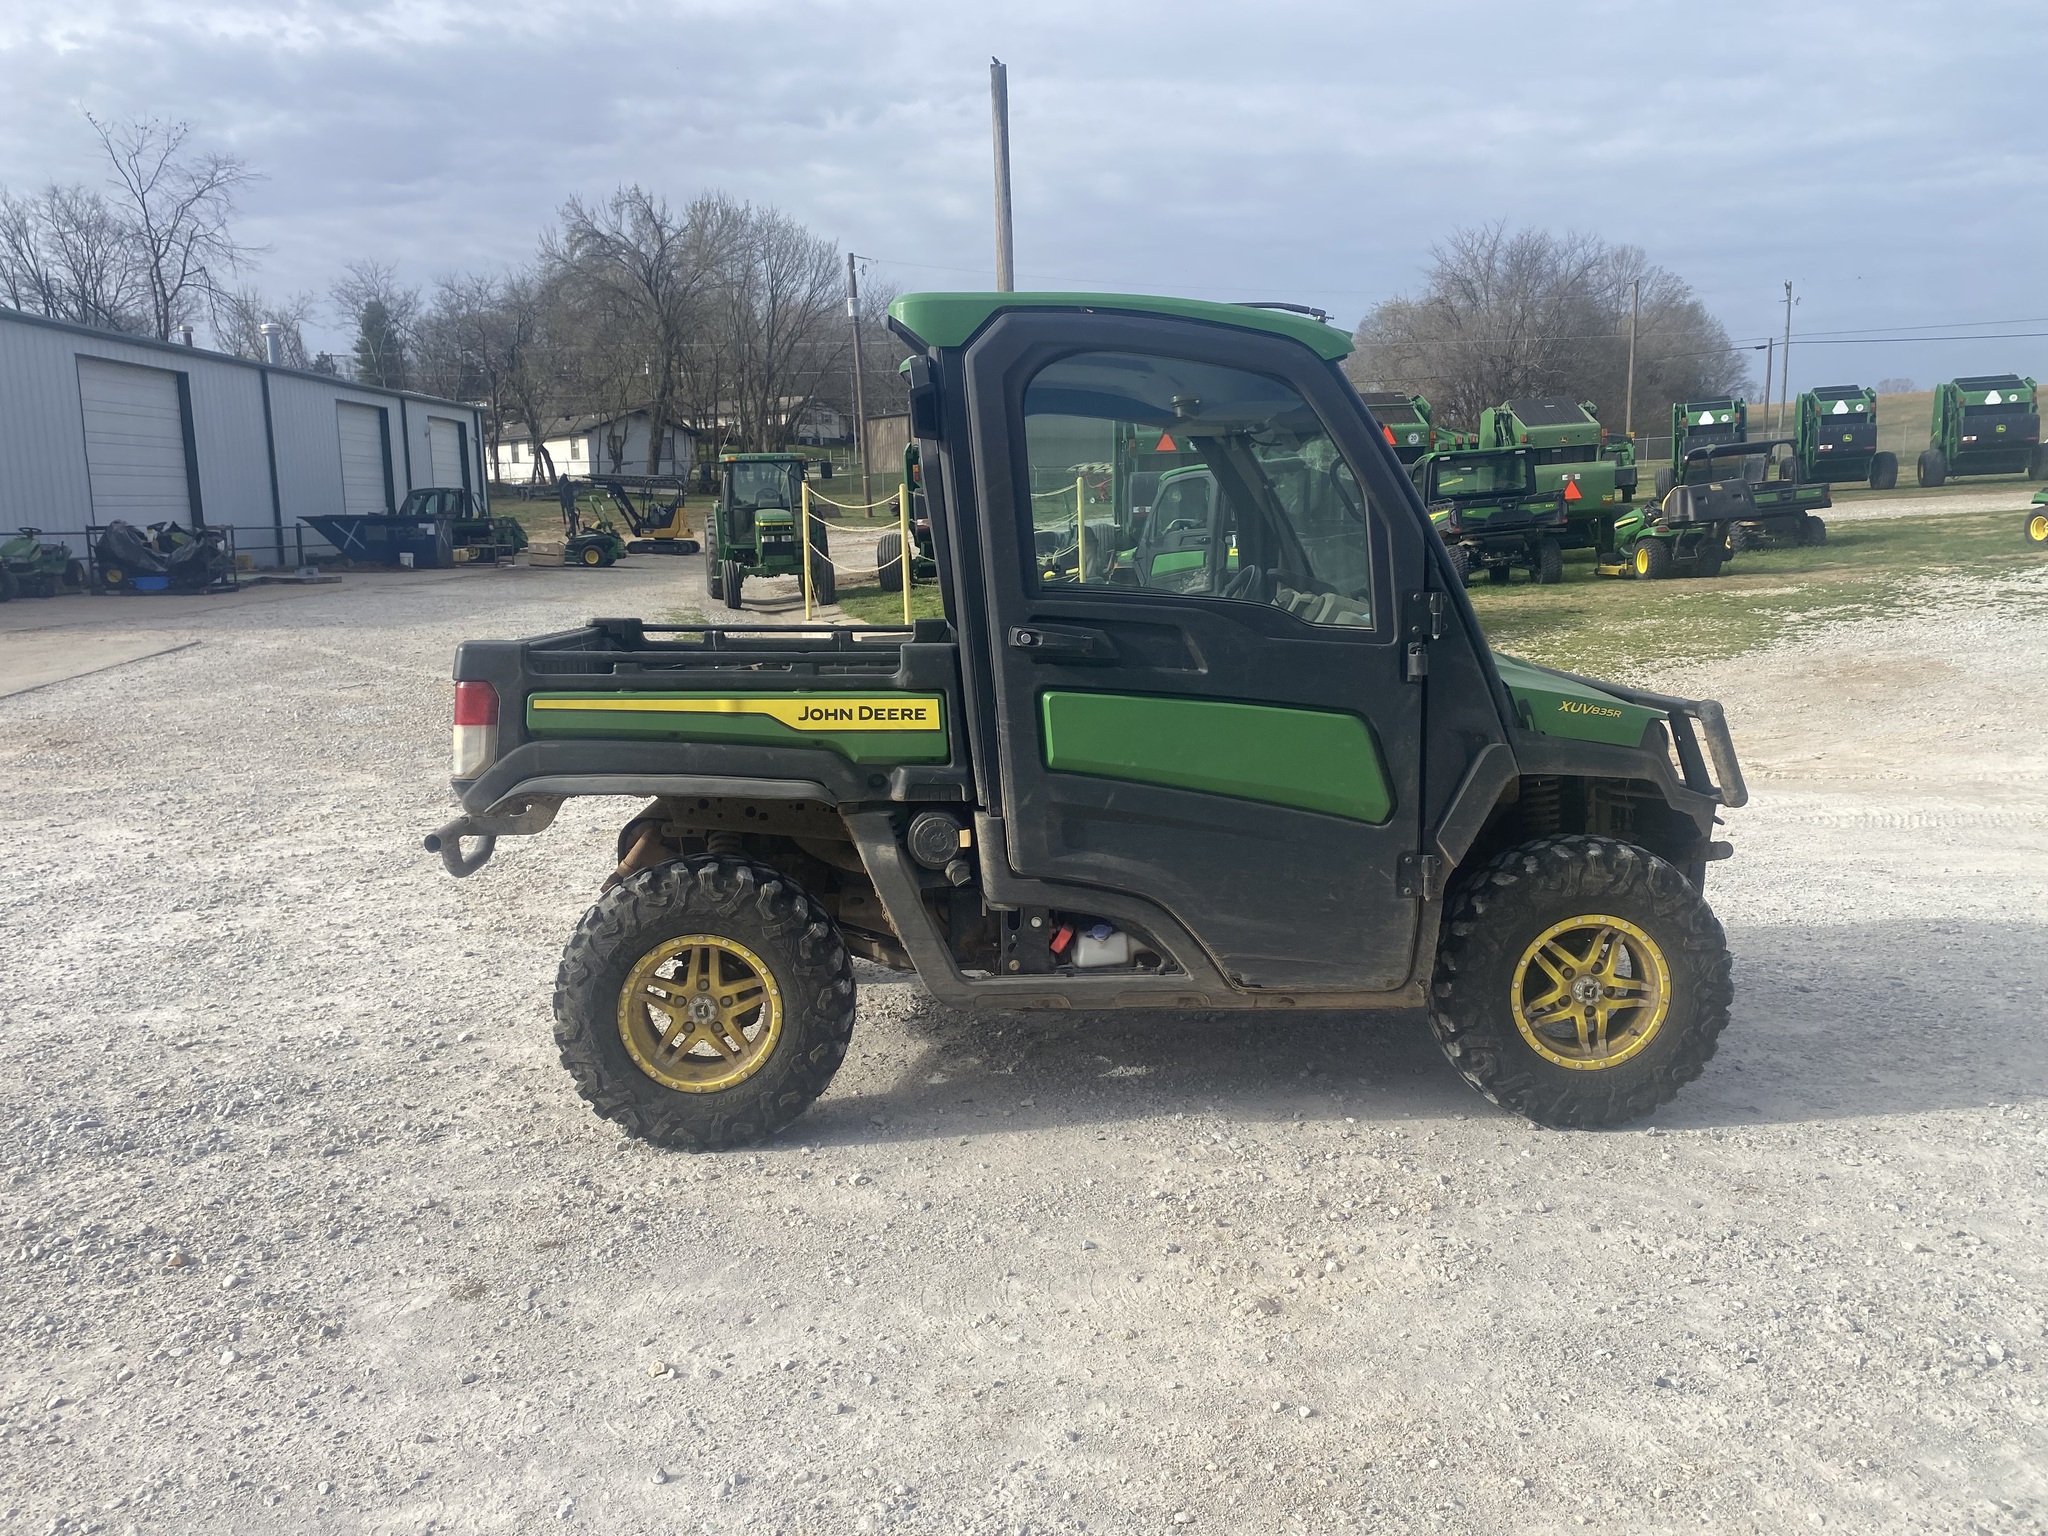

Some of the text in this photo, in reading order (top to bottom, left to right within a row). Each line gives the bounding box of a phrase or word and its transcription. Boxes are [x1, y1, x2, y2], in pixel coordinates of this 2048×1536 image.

[798, 706, 927, 721] JOHN DEERE
[1557, 701, 1622, 718] XUV835R
